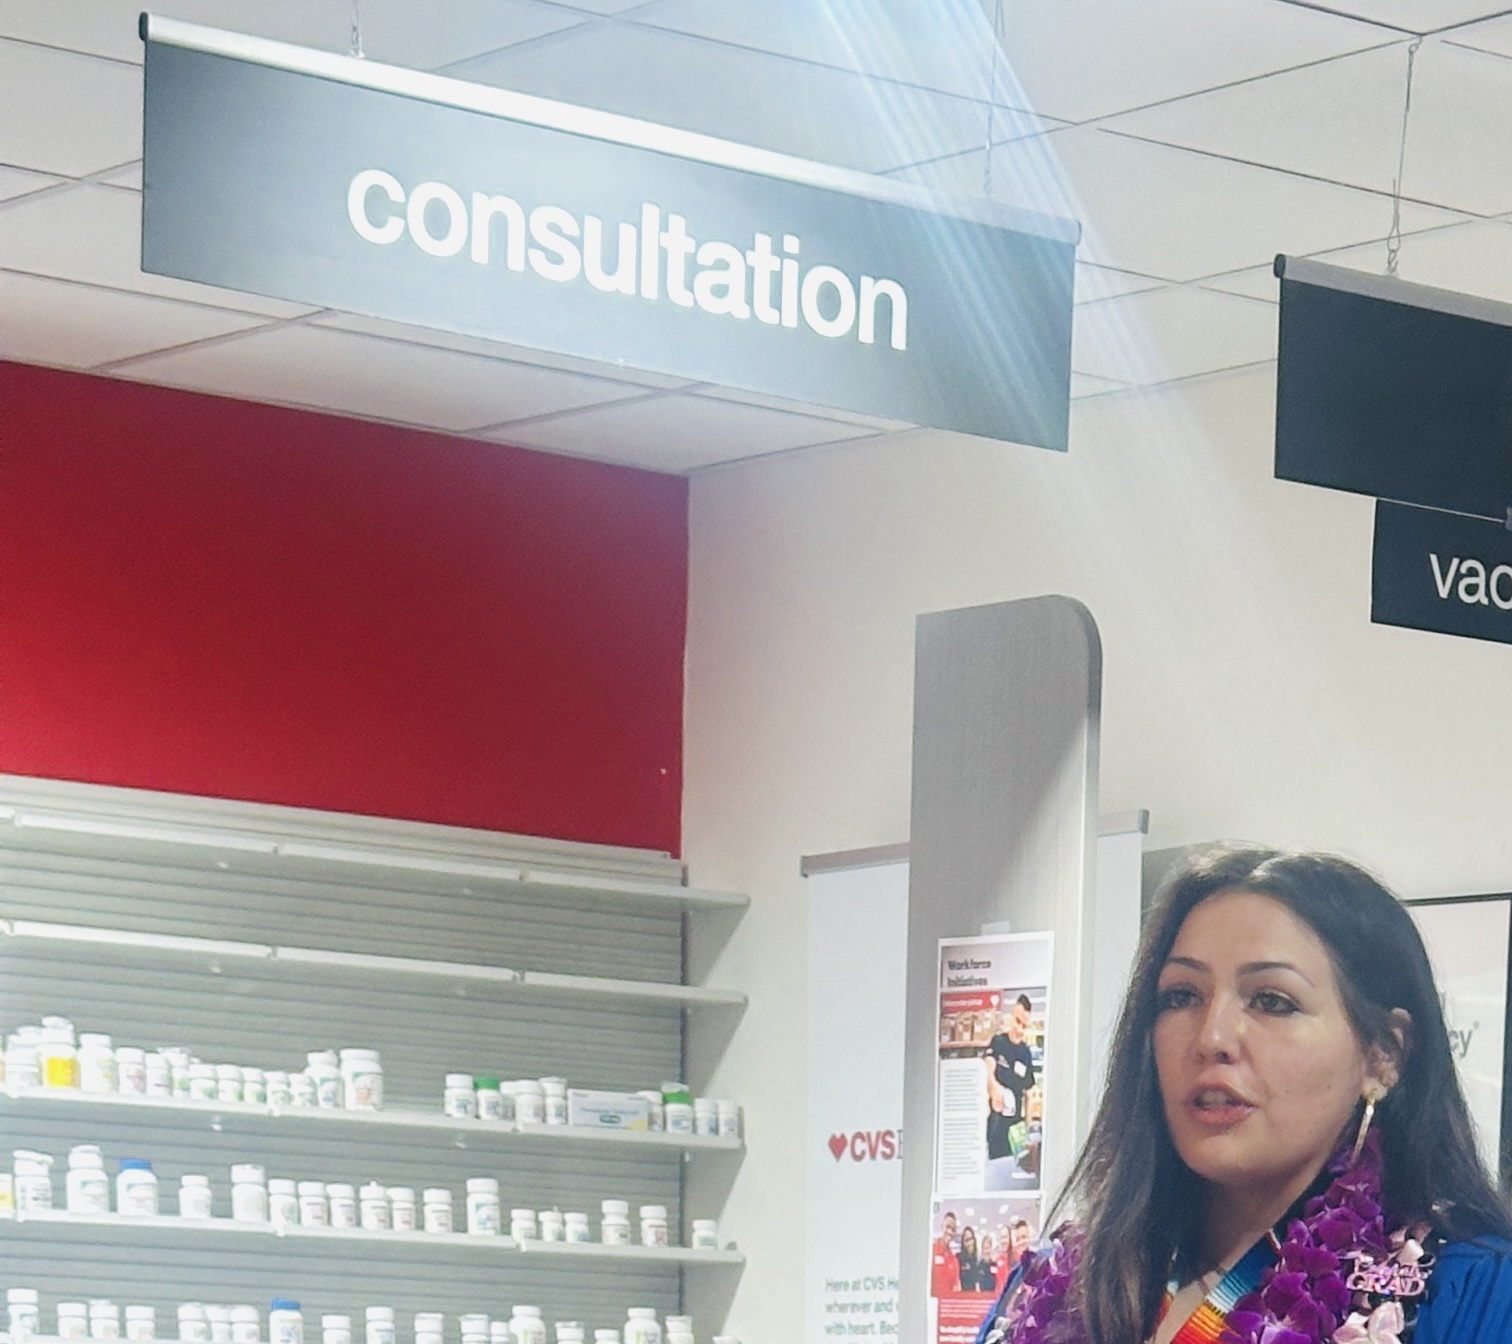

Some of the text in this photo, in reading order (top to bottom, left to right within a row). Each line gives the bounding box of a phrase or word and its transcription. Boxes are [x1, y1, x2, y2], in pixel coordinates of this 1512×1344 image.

[347, 169, 908, 350] consultation
[824, 1276, 850, 1292] Here
[851, 1278, 862, 1291] at
[863, 1275, 886, 1291] CVS
[873, 1298, 894, 1313] and
